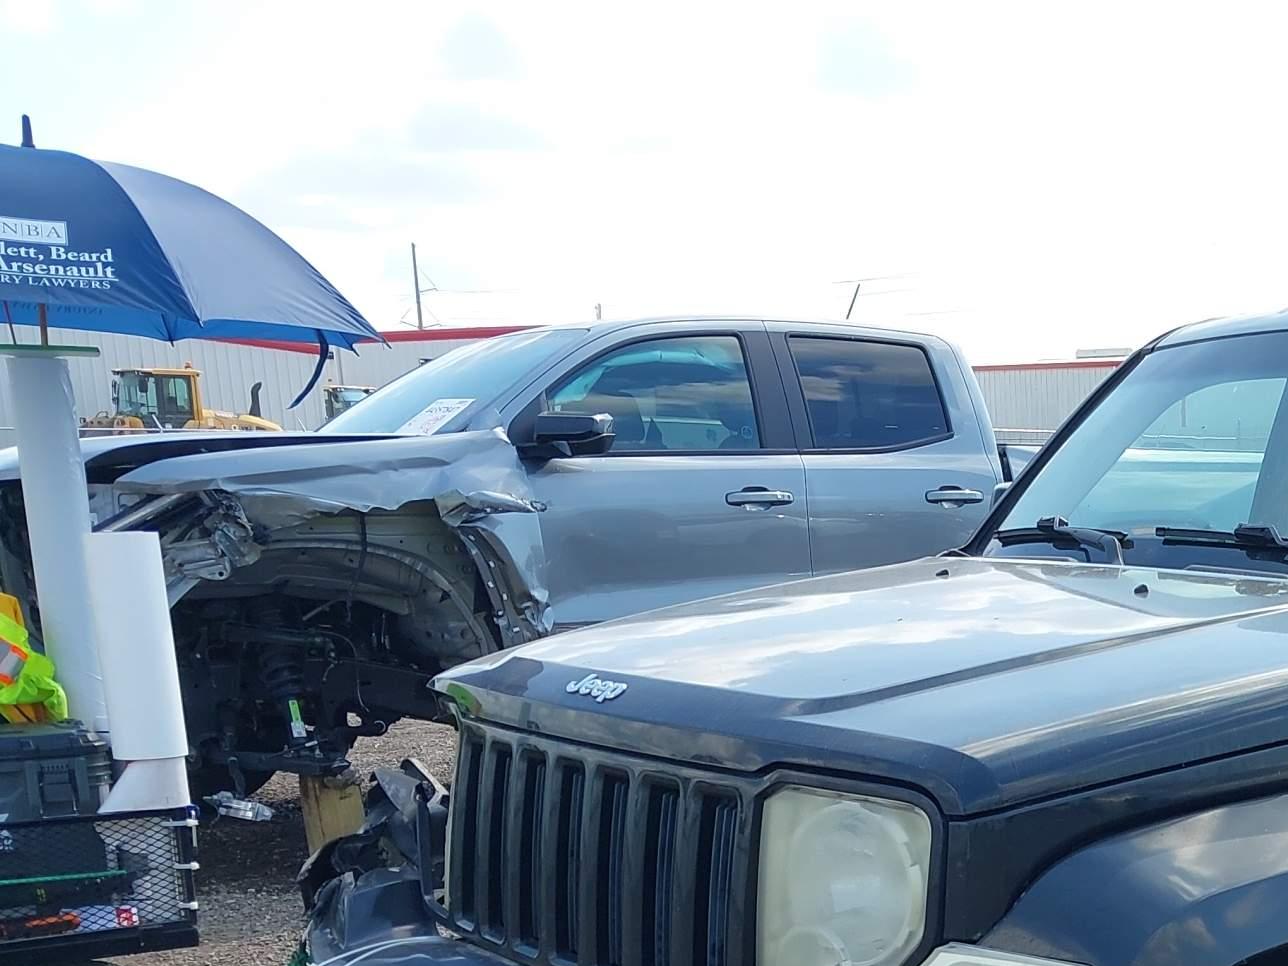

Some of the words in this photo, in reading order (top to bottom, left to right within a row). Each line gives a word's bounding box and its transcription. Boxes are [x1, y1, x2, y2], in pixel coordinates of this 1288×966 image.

[49, 246, 115, 262] Beard
[28, 276, 111, 290] LAWYERS
[565, 673, 628, 703] Jeep
